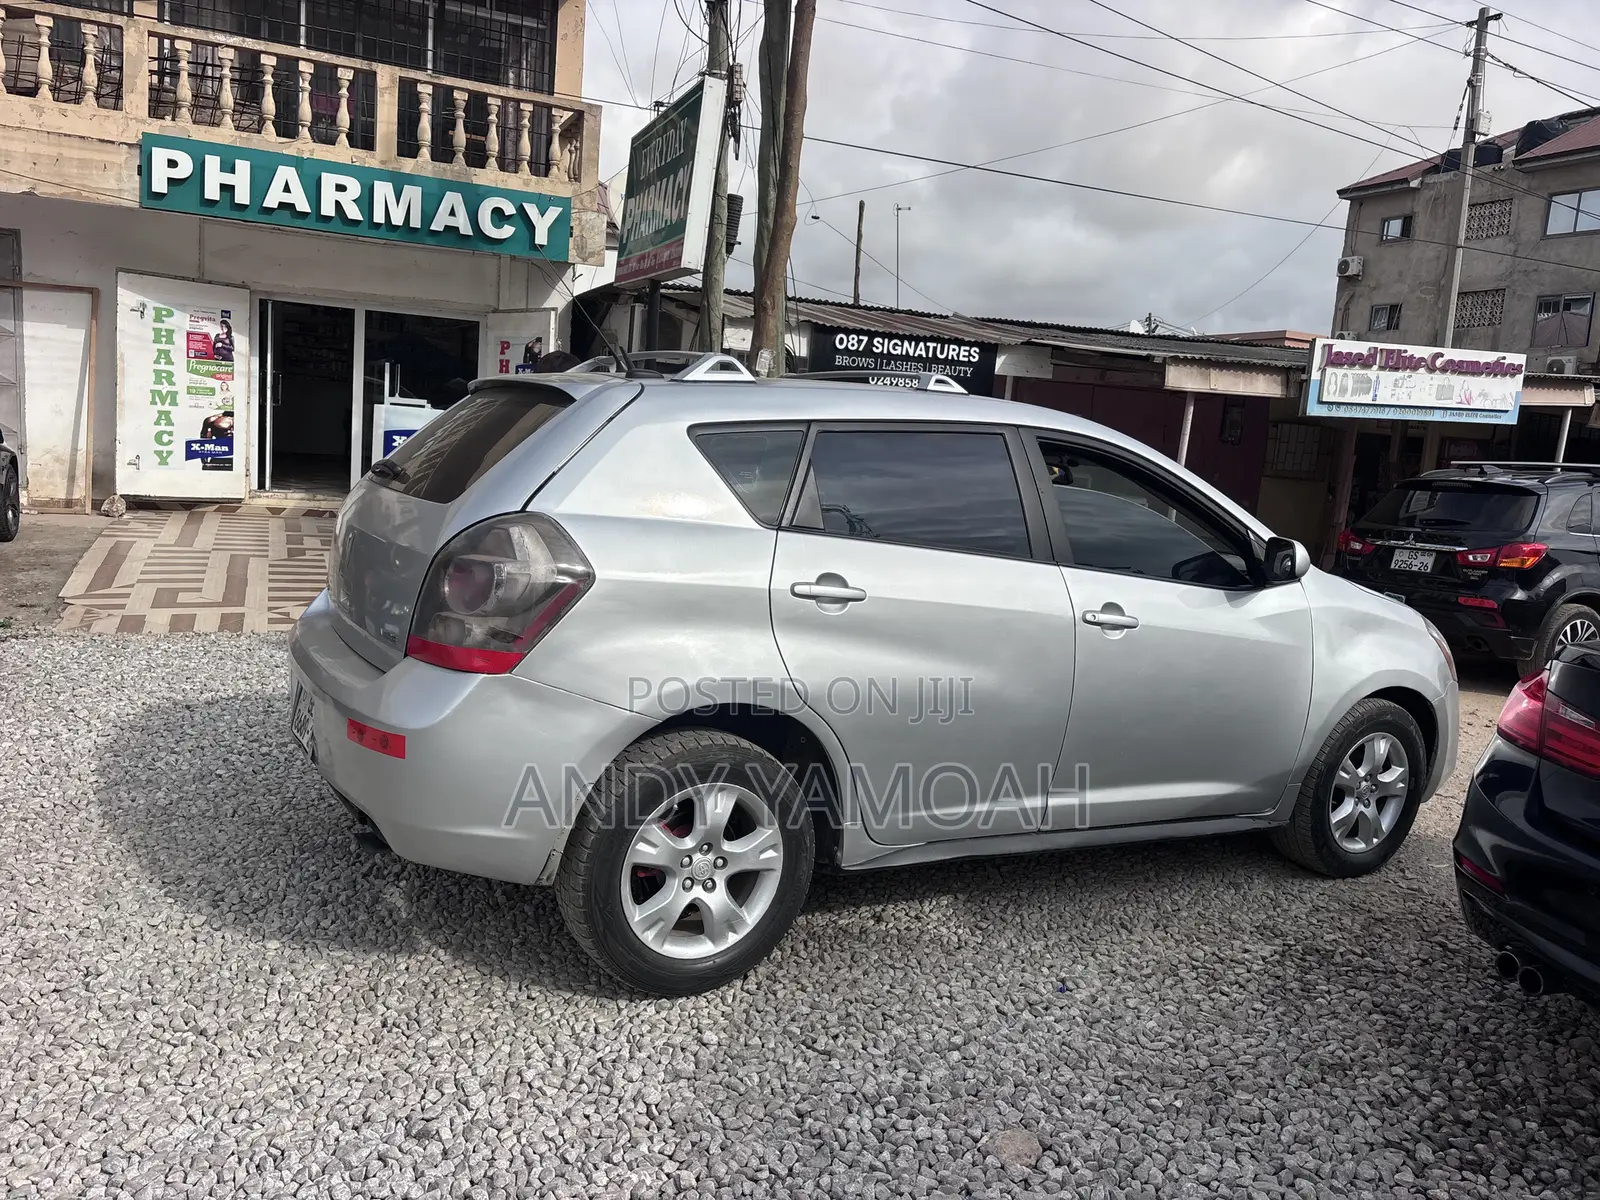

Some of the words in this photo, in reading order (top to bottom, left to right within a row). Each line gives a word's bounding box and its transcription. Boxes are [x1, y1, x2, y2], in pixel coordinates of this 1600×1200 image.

[640, 117, 688, 180] EVERYDAY
[151, 147, 563, 245] PHARMACY
[623, 161, 692, 244] PHARMACY
[835, 333, 868, 352] 087
[872, 337, 980, 362] SIGNATURES
[1323, 343, 1378, 368] Jased
[1380, 347, 1428, 371] Elite
[1428, 351, 1524, 376] Cosmetics
[188, 360, 234, 373] Pregnacare
[835, 355, 875, 369] BROWS
[882, 360, 923, 373] LASHES
[931, 364, 974, 377] BEAUTY
[150, 306, 179, 466] PHARMACY
[190, 443, 229, 452] X-Man
[1394, 559, 1429, 571] 9256-26
[1408, 550, 1419, 560] GS
